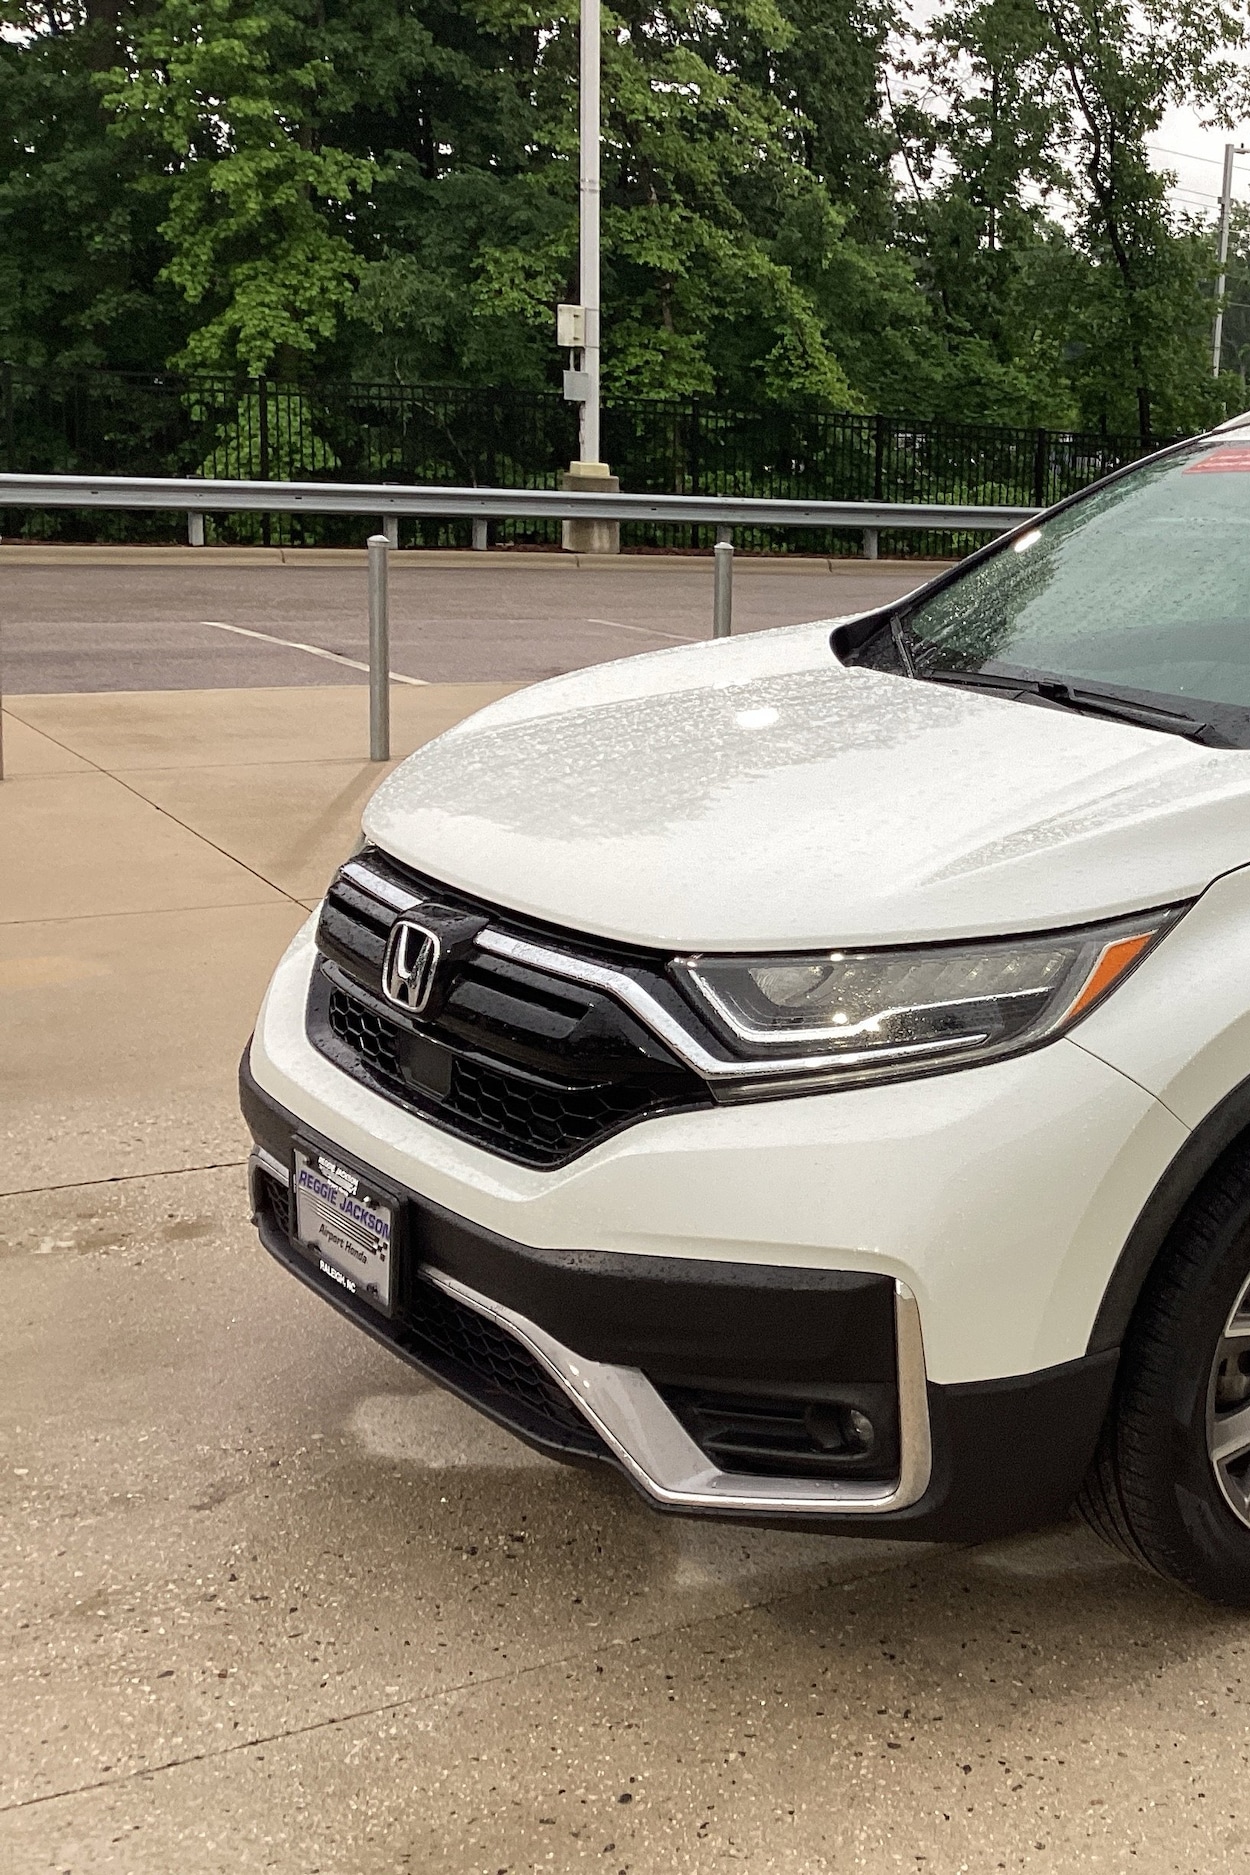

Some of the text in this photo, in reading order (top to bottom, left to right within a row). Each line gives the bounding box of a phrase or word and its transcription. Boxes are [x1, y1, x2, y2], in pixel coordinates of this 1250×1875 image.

[299, 1170, 338, 1204] REGGIE
[339, 1196, 391, 1239] JACKSON
[319, 1223, 368, 1264] Airport Honda
[346, 1279, 356, 1294] NC
